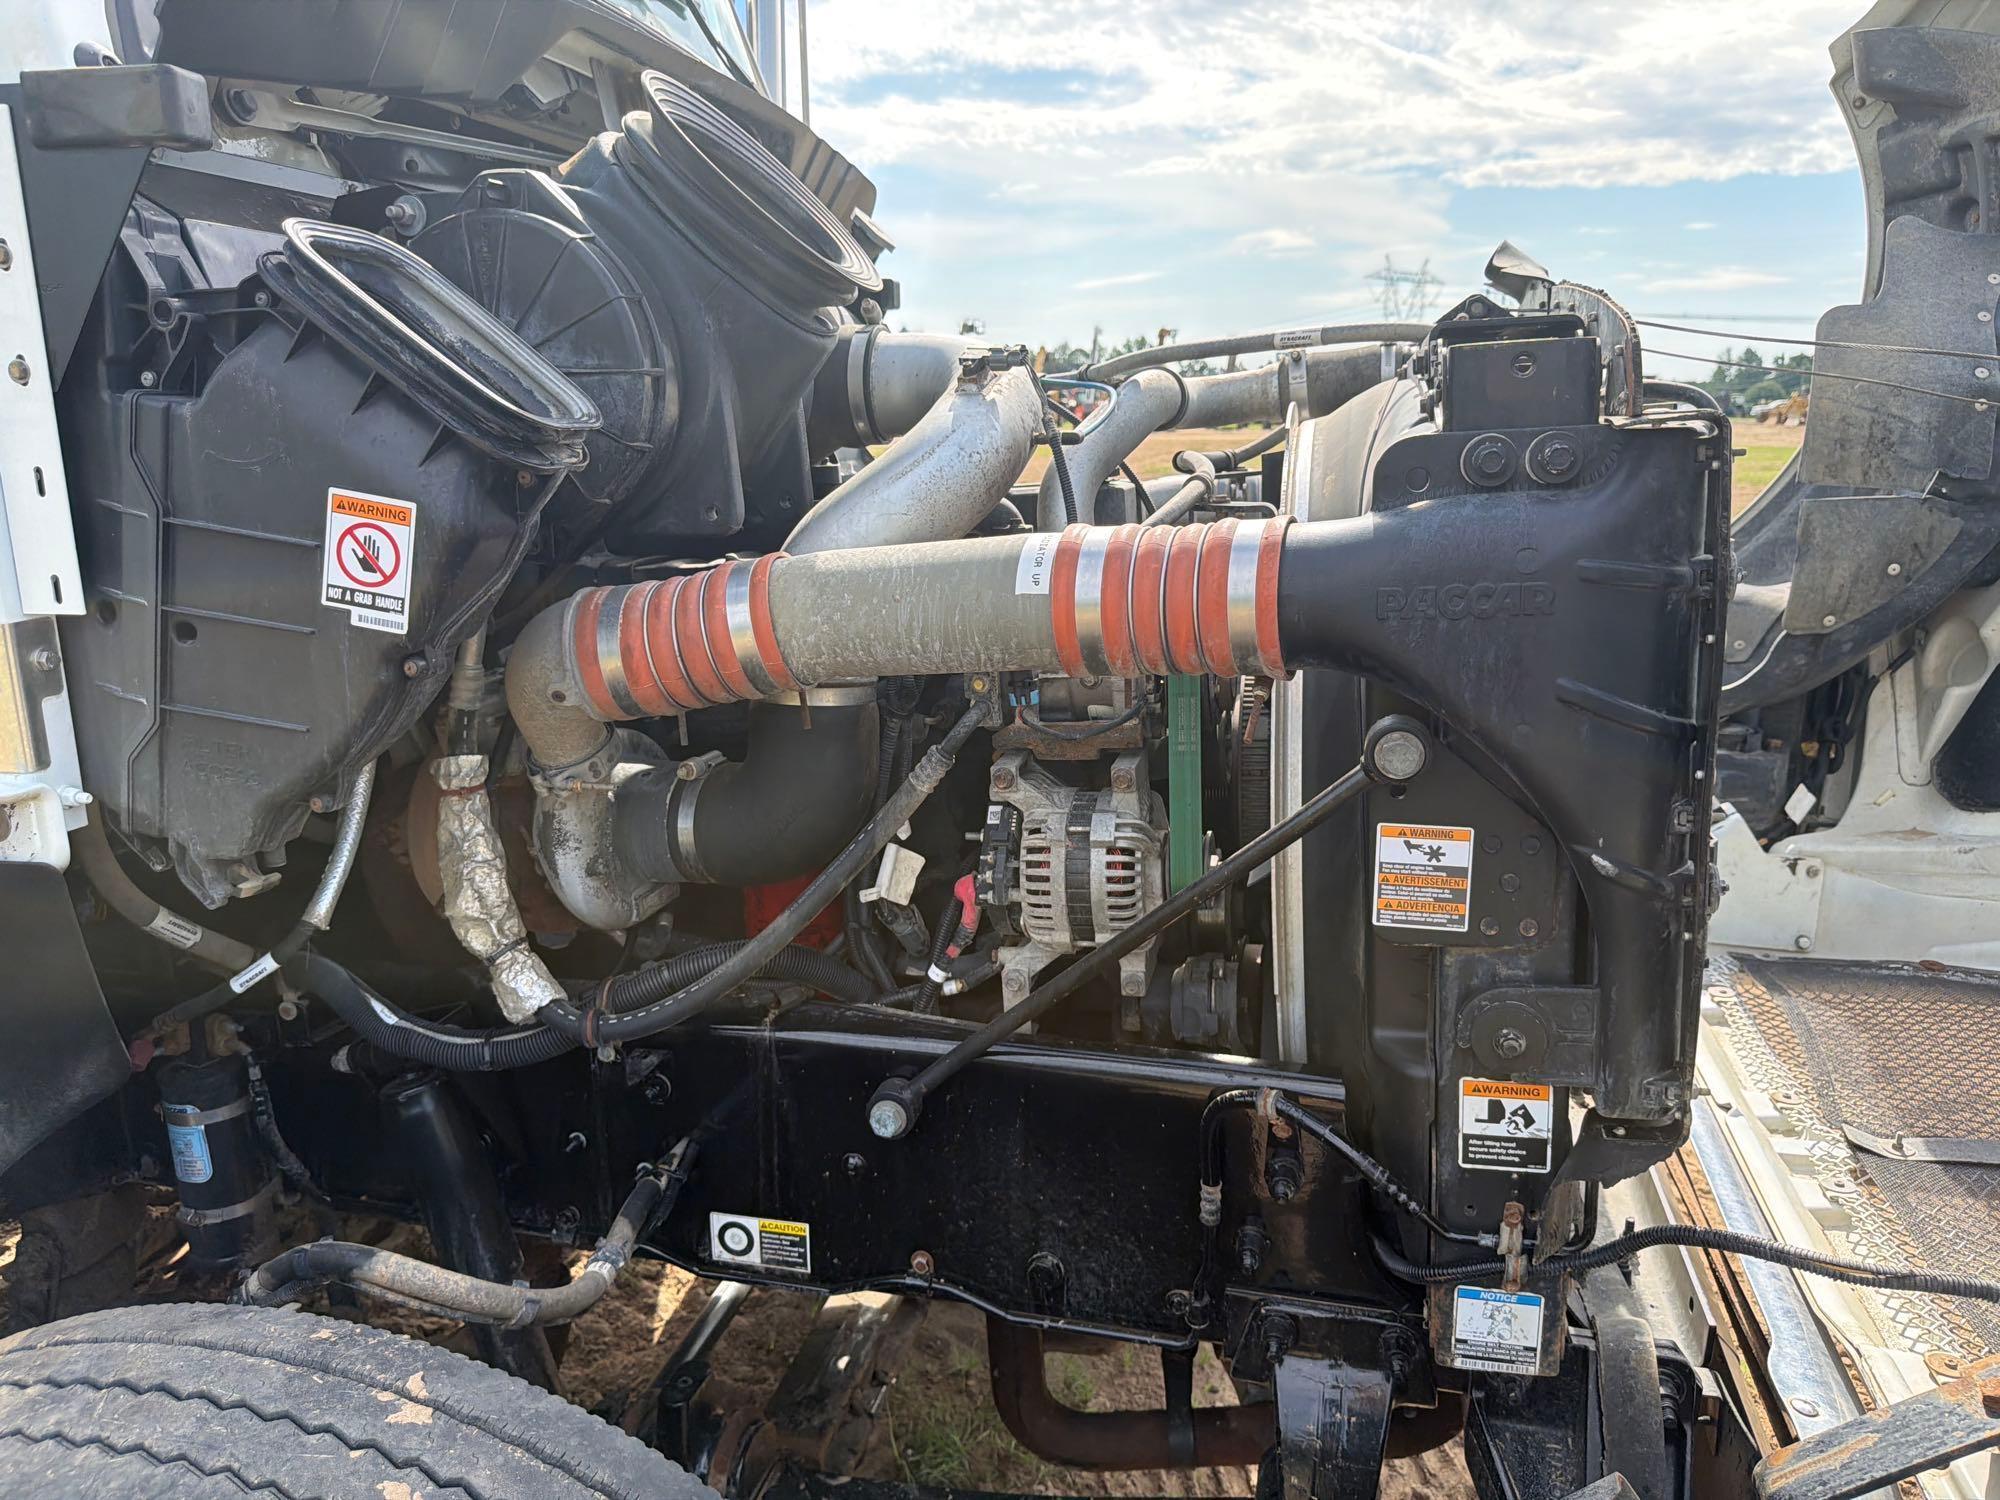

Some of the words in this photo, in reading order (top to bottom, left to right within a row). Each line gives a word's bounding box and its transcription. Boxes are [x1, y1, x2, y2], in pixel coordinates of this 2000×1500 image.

[346, 501, 407, 522] WARNING
[1032, 574, 1040, 586] UP
[328, 587, 342, 600] NOT
[345, 591, 351, 601] A
[354, 591, 372, 605] GRAB
[376, 595, 402, 612] HANDLE
[1376, 582, 1555, 621] PACCAR
[1410, 829, 1454, 838] WARNING
[1393, 876, 1465, 887] AVERTISSEMENT
[1396, 901, 1460, 913] ADVERTENCIA
[1481, 1085, 1540, 1096] WARNING
[767, 1222, 806, 1233] CAUTION
[1480, 1292, 1518, 1302] NOTICE
